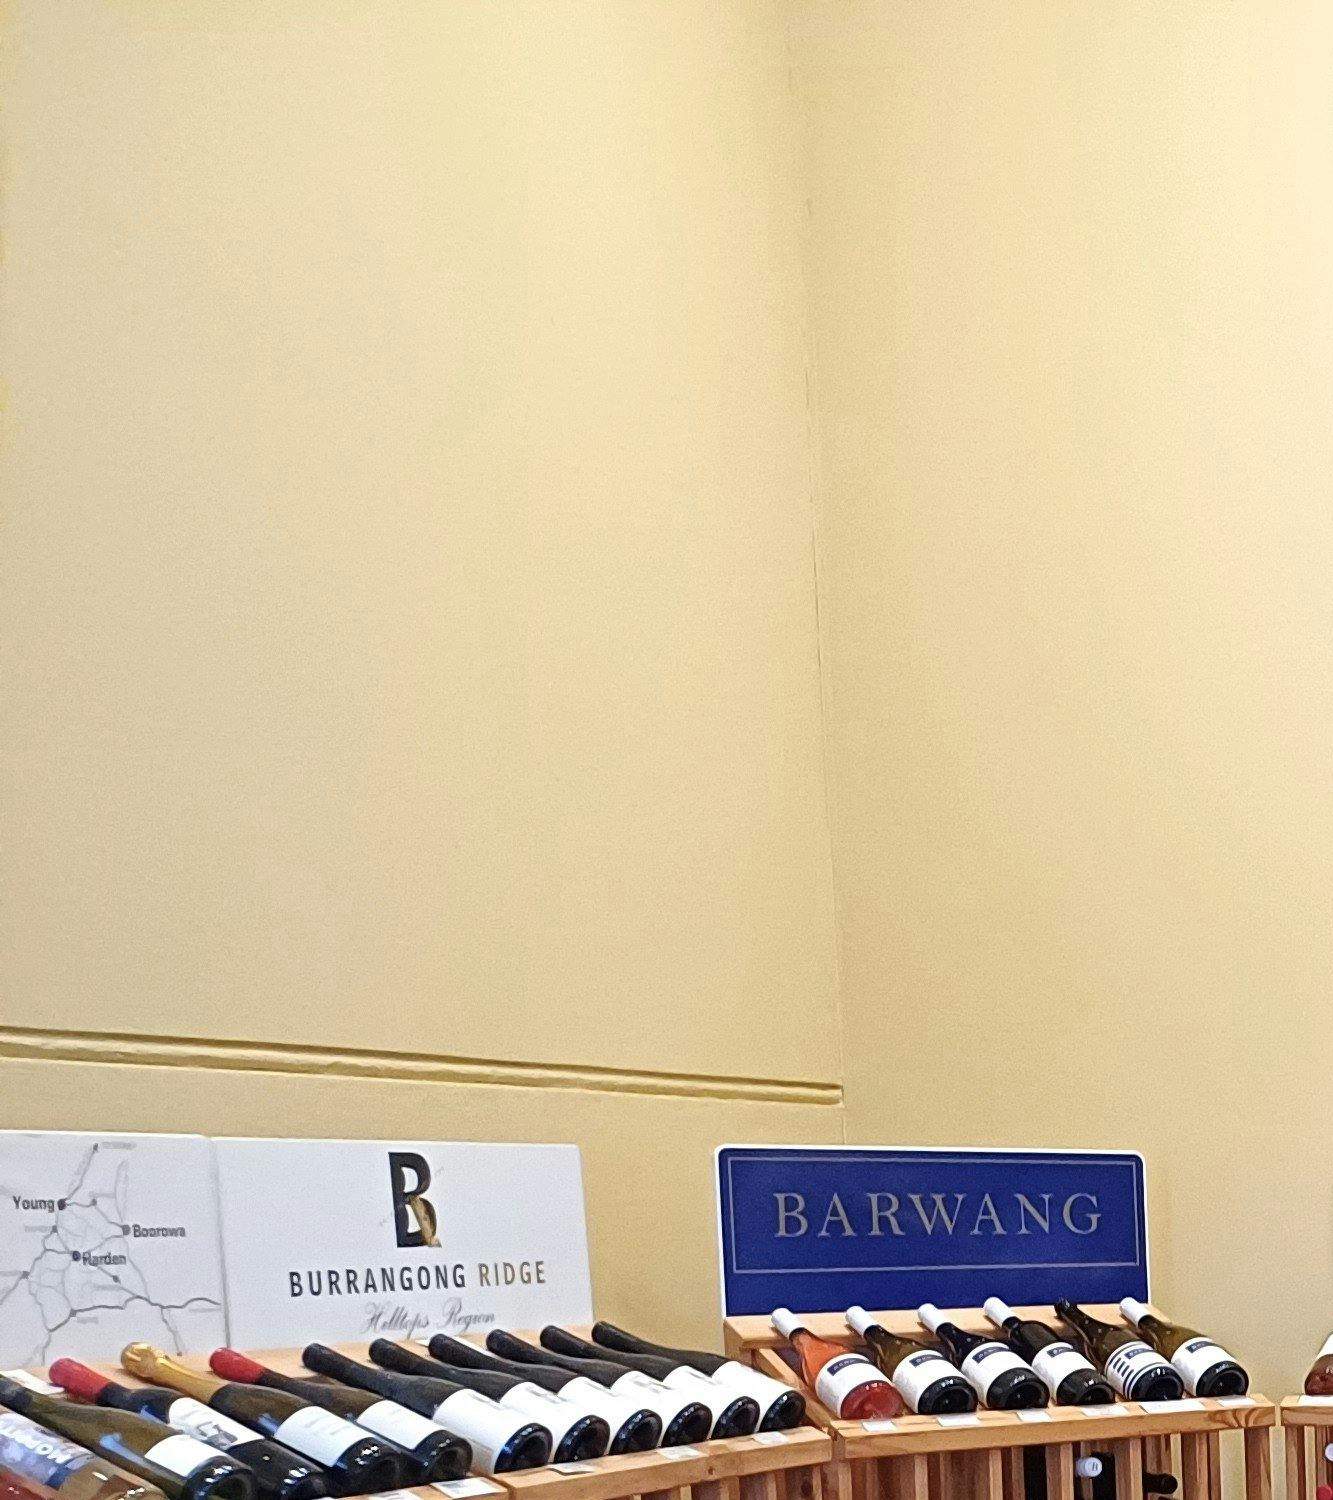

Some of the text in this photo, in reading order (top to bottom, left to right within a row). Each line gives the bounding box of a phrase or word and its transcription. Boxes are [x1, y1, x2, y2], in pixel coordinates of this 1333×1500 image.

[12, 1195, 55, 1214] Young
[772, 1192, 1102, 1238] BARWANG
[288, 1260, 546, 1298] BURRANGONG RIDGE
